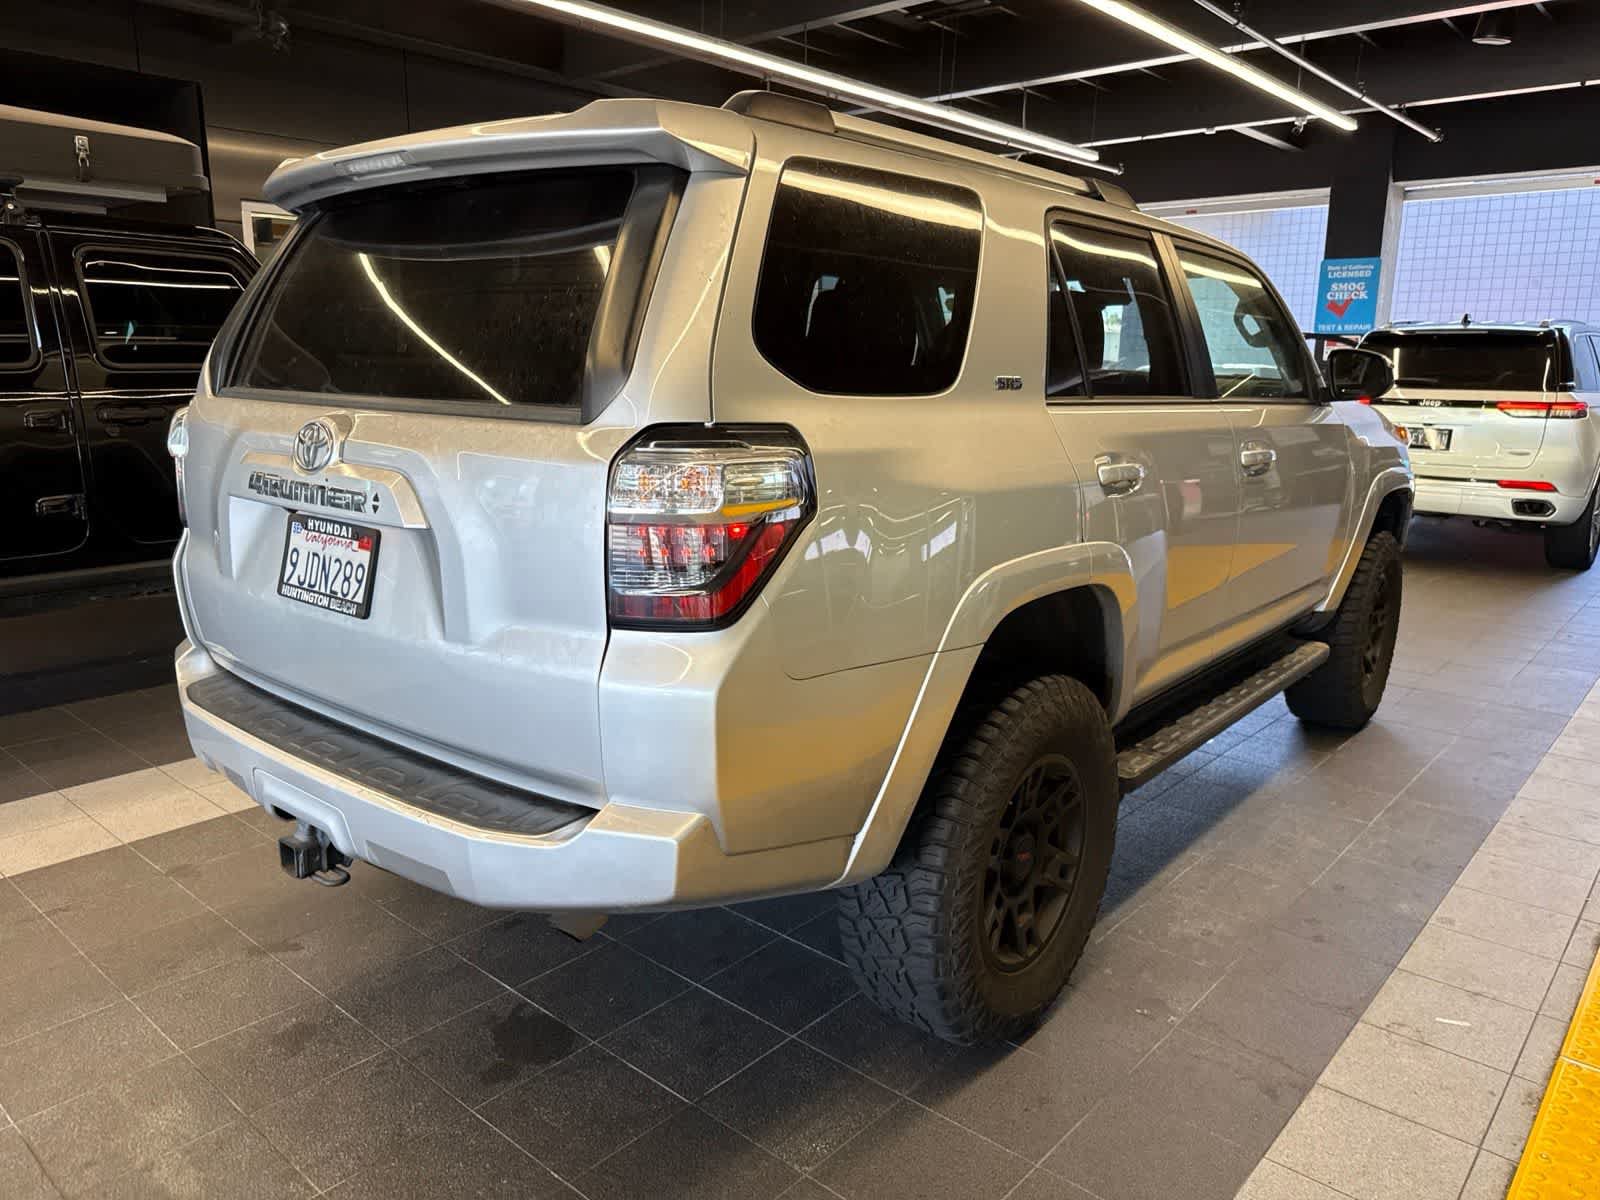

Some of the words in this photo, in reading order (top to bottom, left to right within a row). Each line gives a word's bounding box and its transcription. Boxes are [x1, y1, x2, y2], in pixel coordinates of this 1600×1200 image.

[1328, 270, 1372, 278] LICENSED
[1330, 282, 1366, 291] SMOG
[1326, 290, 1368, 300] CHECK
[1419, 399, 1441, 407] Jeep
[307, 518, 353, 539] HYUNDAI
[285, 547, 366, 601] 9JDN289
[281, 583, 330, 608] HUNTINGTON
[329, 596, 358, 616] BEACH
